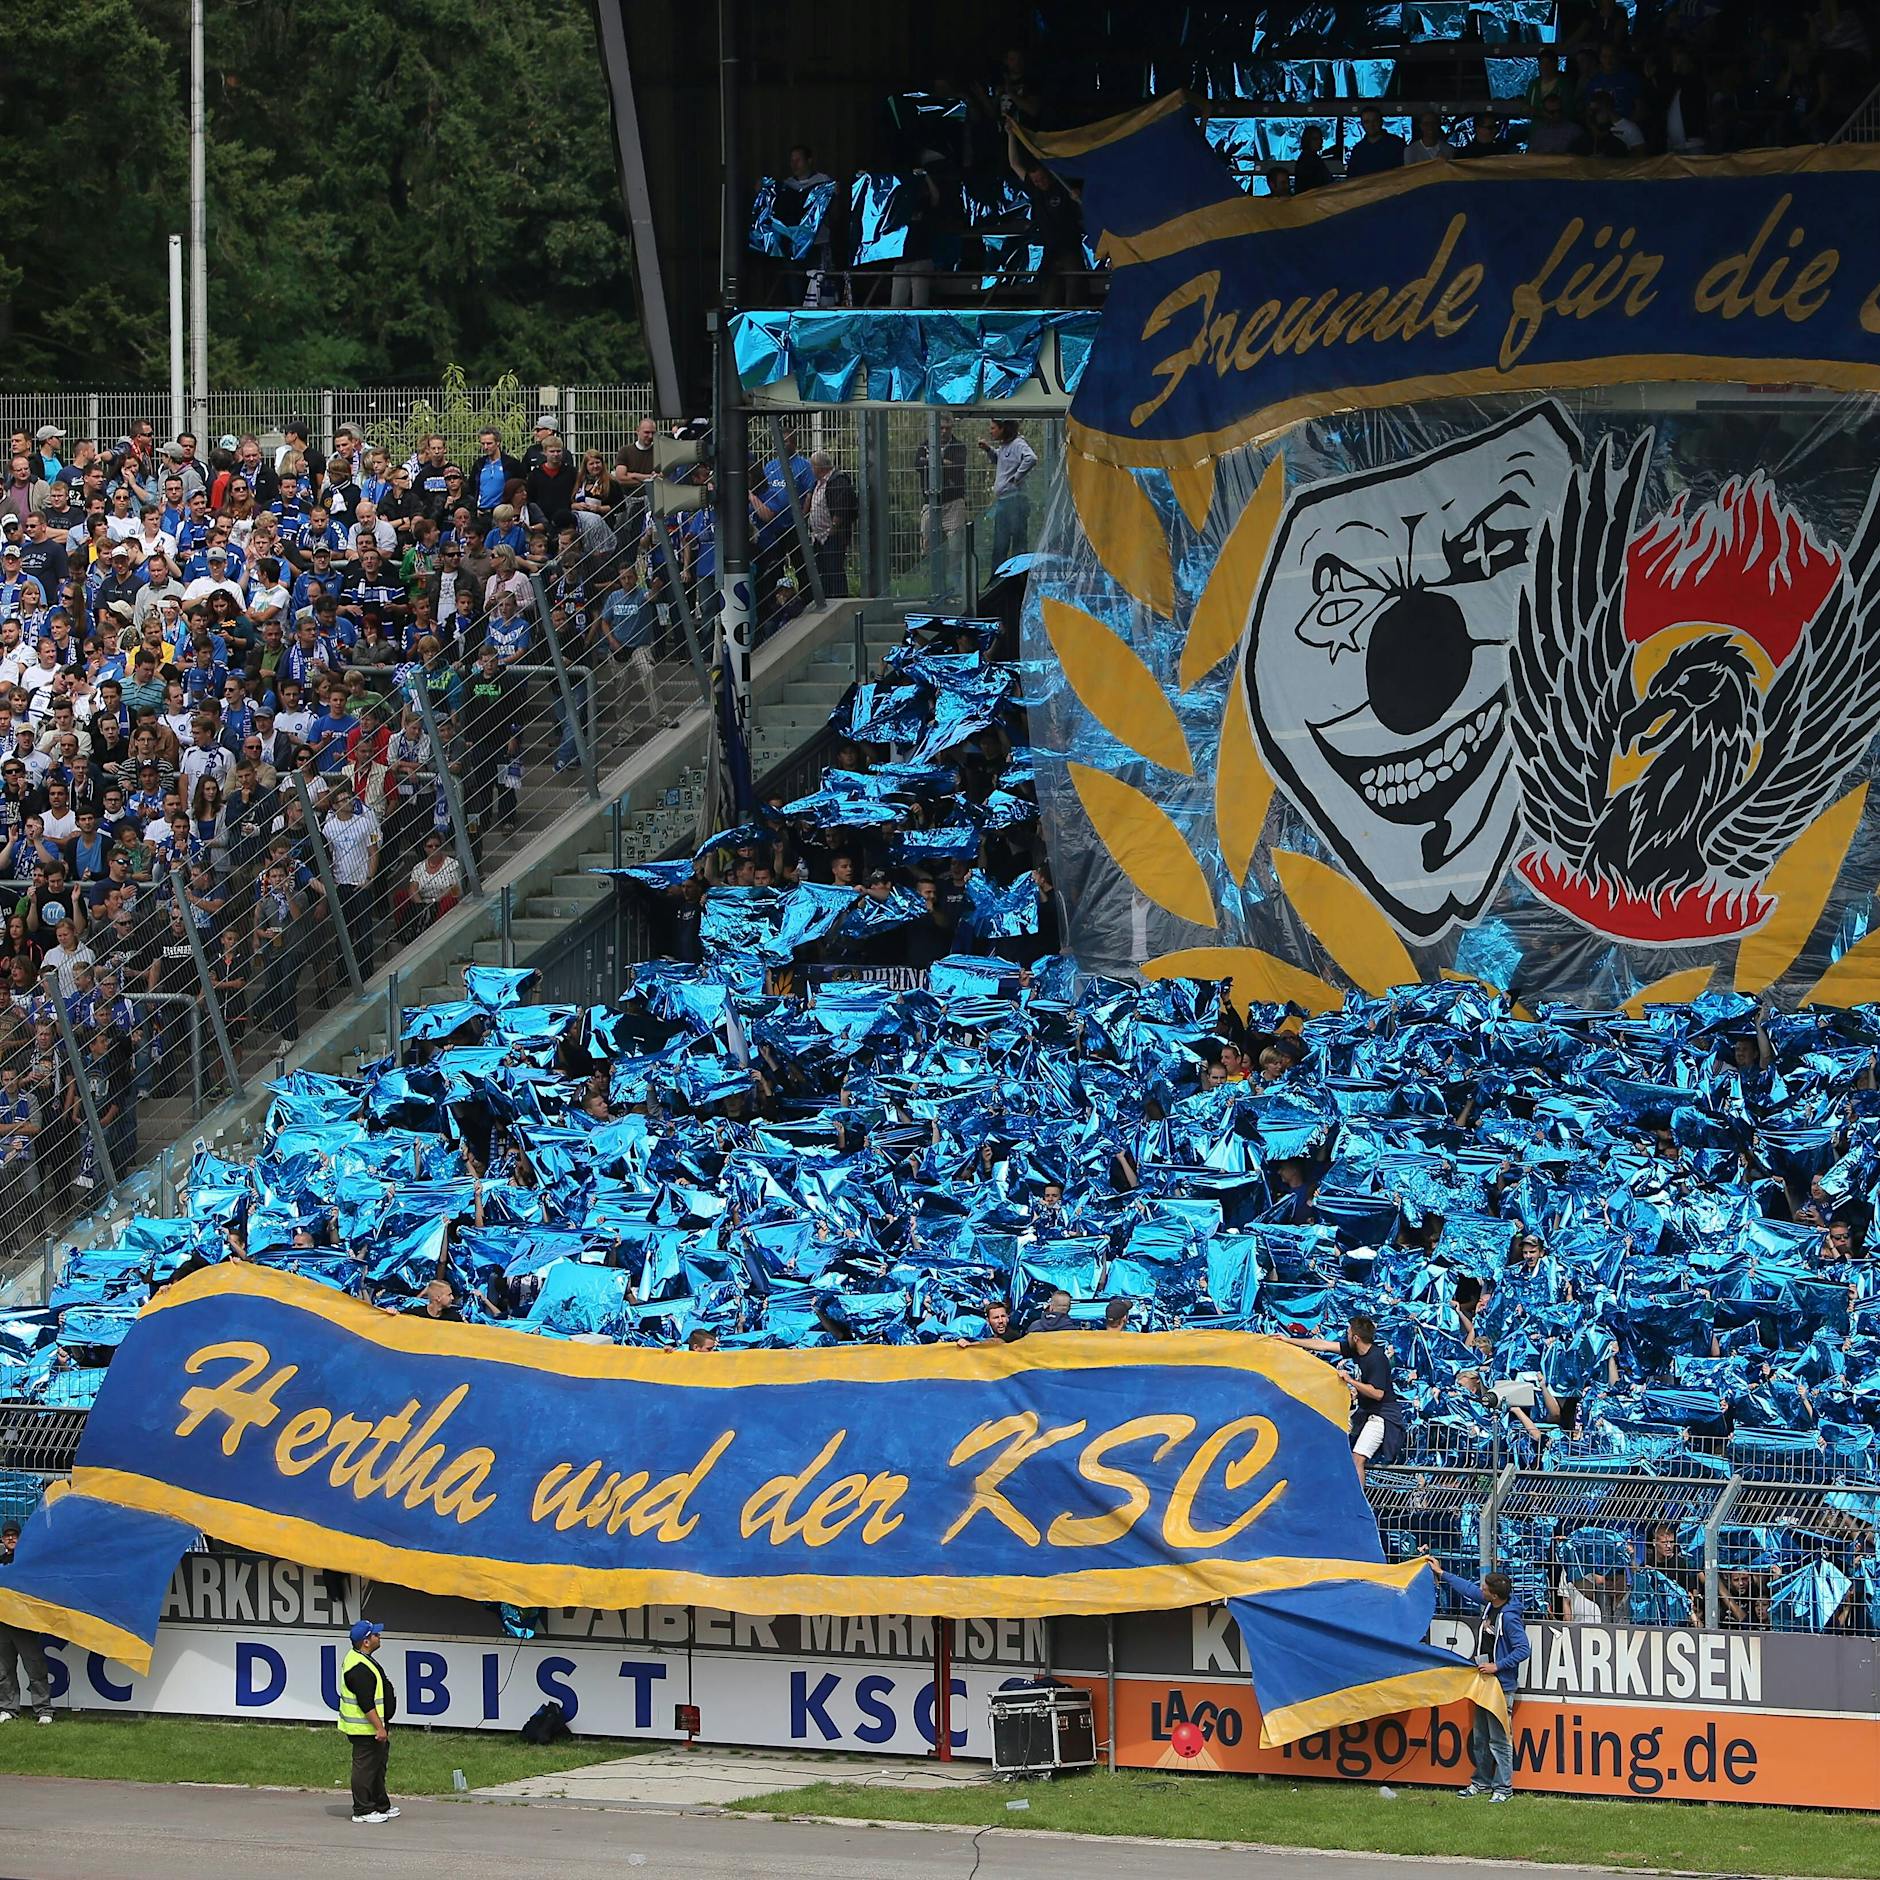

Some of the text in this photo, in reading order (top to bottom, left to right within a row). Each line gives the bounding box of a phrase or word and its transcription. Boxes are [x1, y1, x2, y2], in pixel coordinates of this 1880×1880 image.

[1132, 212, 1486, 428] Freunde
[1499, 217, 1664, 371] für
[1695, 193, 1840, 322] die
[174, 1340, 1288, 1549] Hertha und der KSC
[790, 1671, 968, 1748] KSC
[1151, 1688, 1243, 1747] LAGO
[1283, 1705, 1758, 1794] ago-bwling.de
